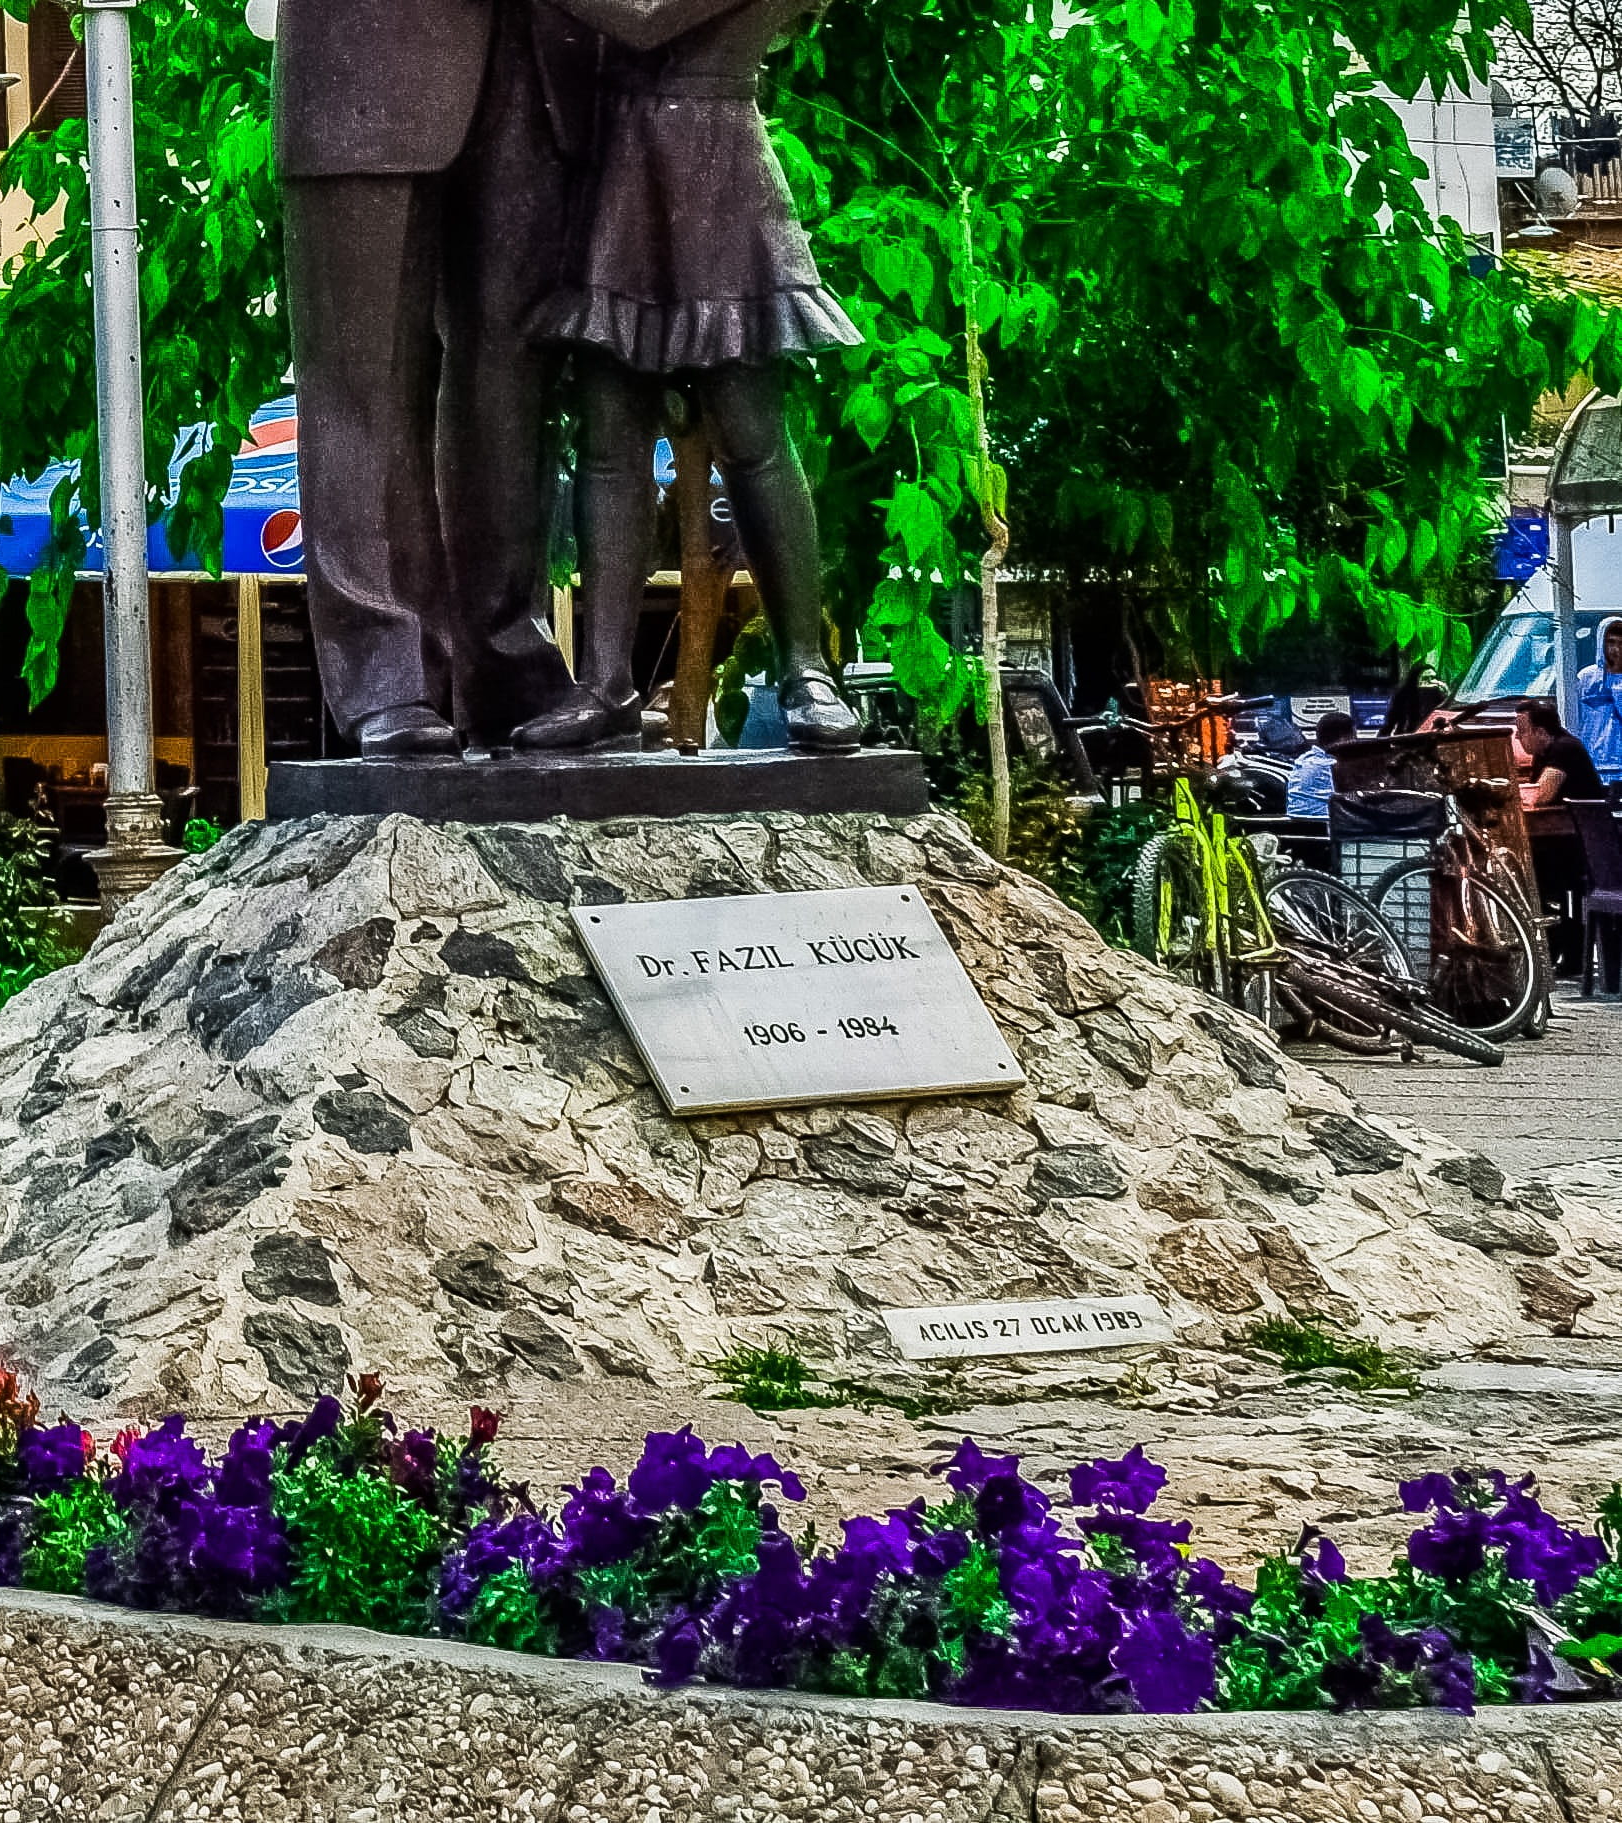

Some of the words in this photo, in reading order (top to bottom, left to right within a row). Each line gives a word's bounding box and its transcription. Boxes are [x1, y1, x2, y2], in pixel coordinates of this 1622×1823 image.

[635, 954, 690, 977] Dr.
[690, 945, 795, 974] FAZIL
[744, 1023, 806, 1046] 1906
[837, 1015, 899, 1039] 1984
[993, 1318, 1020, 1337] 27
[1030, 1313, 1089, 1335] OCAK
[1091, 1310, 1143, 1332] 1989
